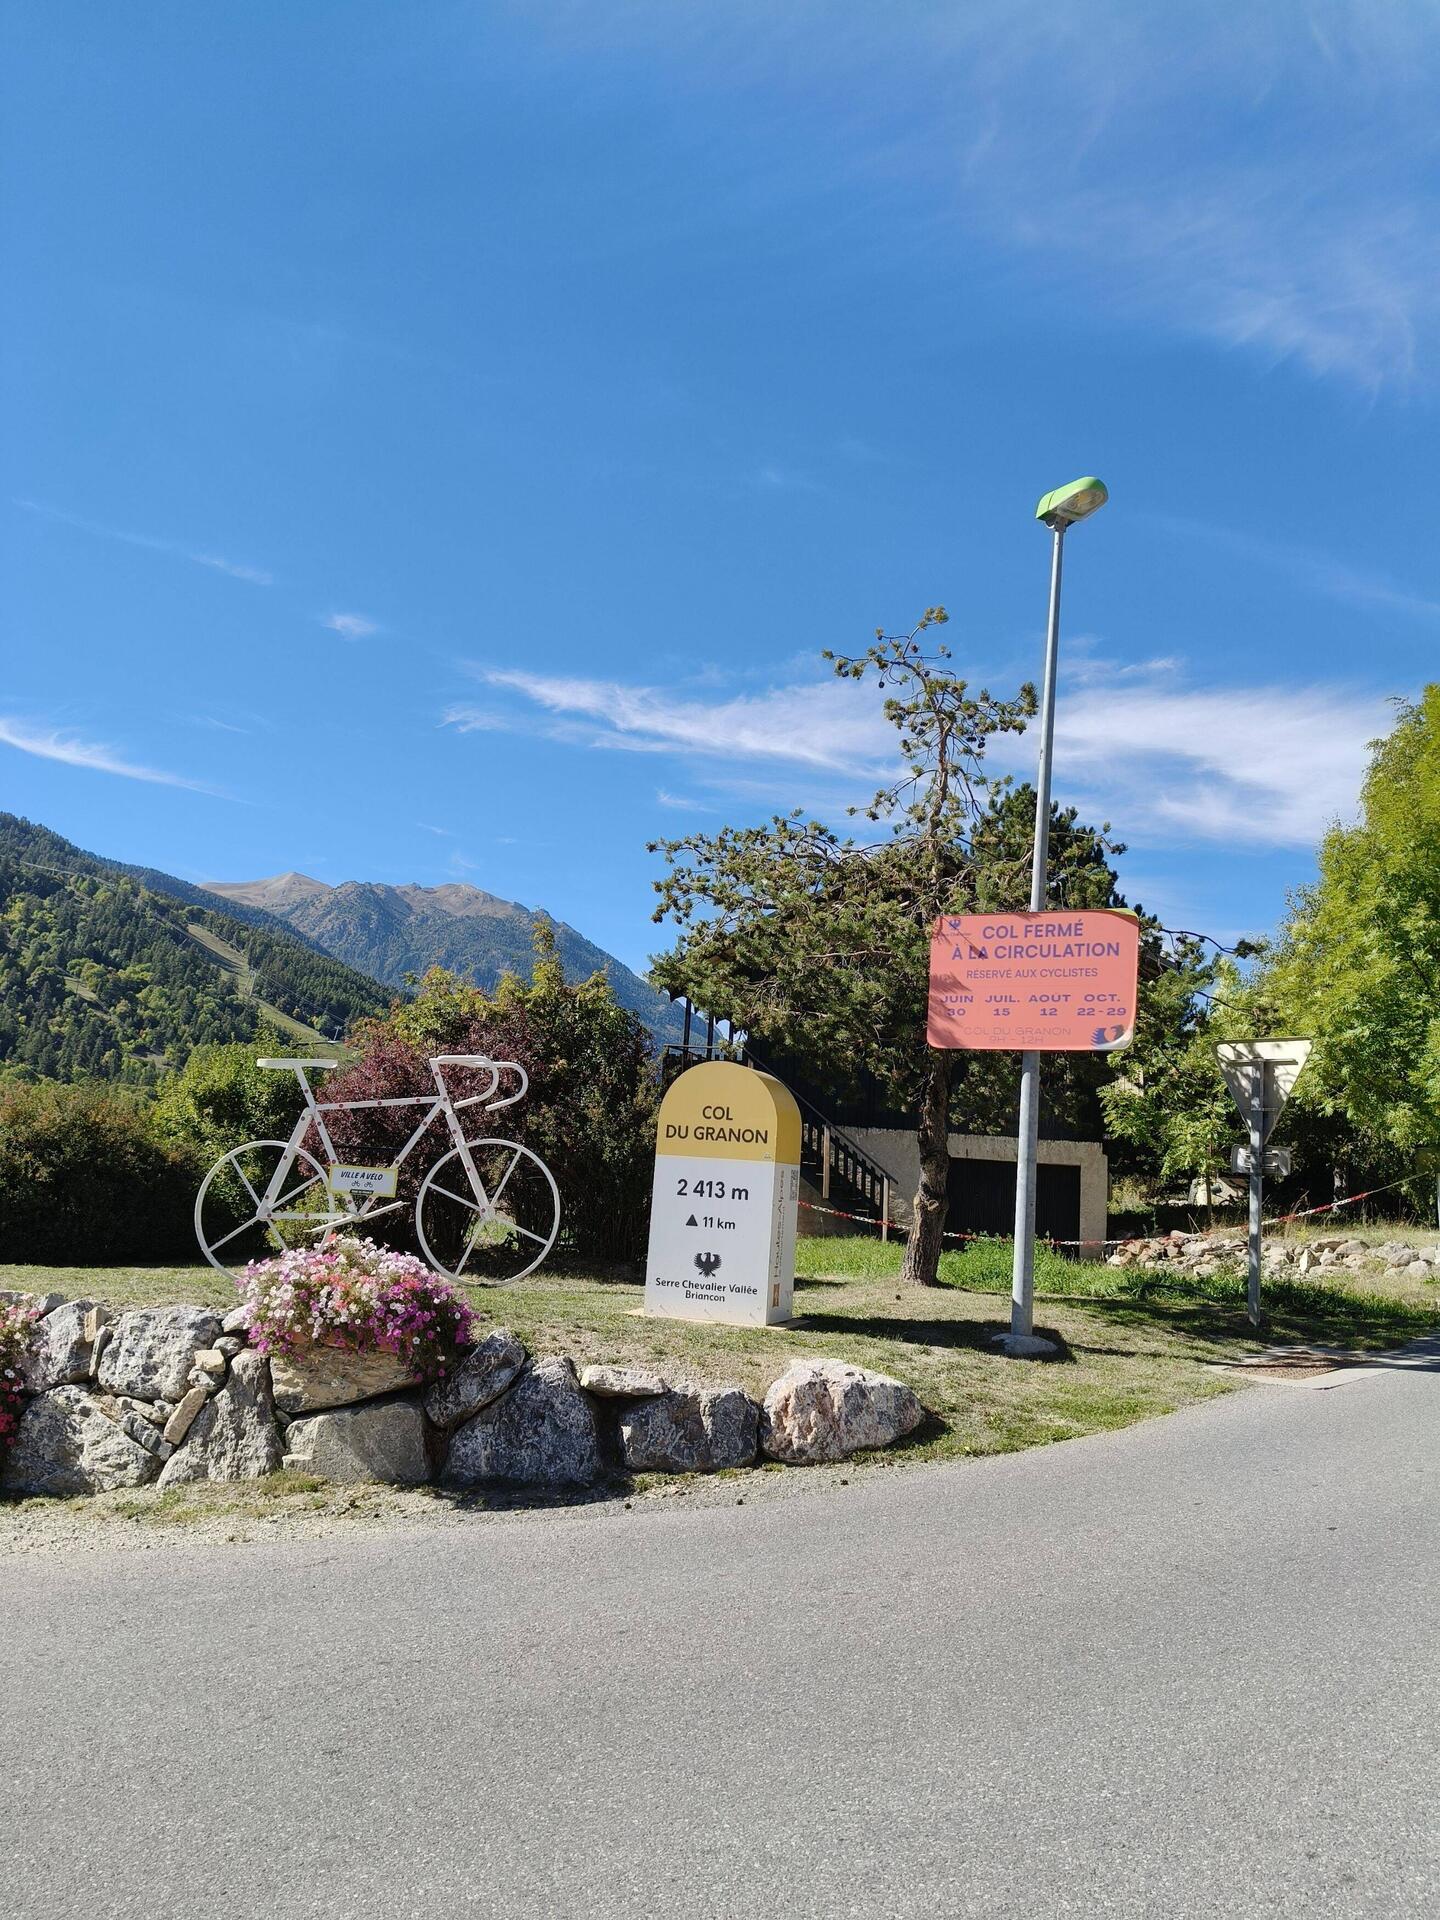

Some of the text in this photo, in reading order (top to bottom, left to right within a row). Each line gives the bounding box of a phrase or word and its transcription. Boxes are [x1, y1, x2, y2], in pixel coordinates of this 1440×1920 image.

[983, 925, 1018, 940] COL
[1024, 919, 1084, 938] FERMÉ
[968, 946, 988, 960] LA
[994, 942, 1120, 959] CIRCULATION
[1014, 968, 1037, 979] AUX
[1039, 967, 1098, 978] CYCLISTES
[940, 995, 974, 1003] JUIN
[984, 994, 1020, 1003] JUIL.
[1084, 993, 1121, 1003] OCT.
[947, 1008, 966, 1016] 30
[993, 1008, 1010, 1016] 15
[1039, 1008, 1058, 1016] 12
[963, 1026, 1072, 1036] COL DU GRANON
[702, 1106, 733, 1121] COL
[666, 1124, 769, 1144] DU GRANON
[731, 1187, 749, 1201] m
[702, 1217, 736, 1230] 11 km
[655, 1277, 758, 1295] Serre Chevalier Vallée
